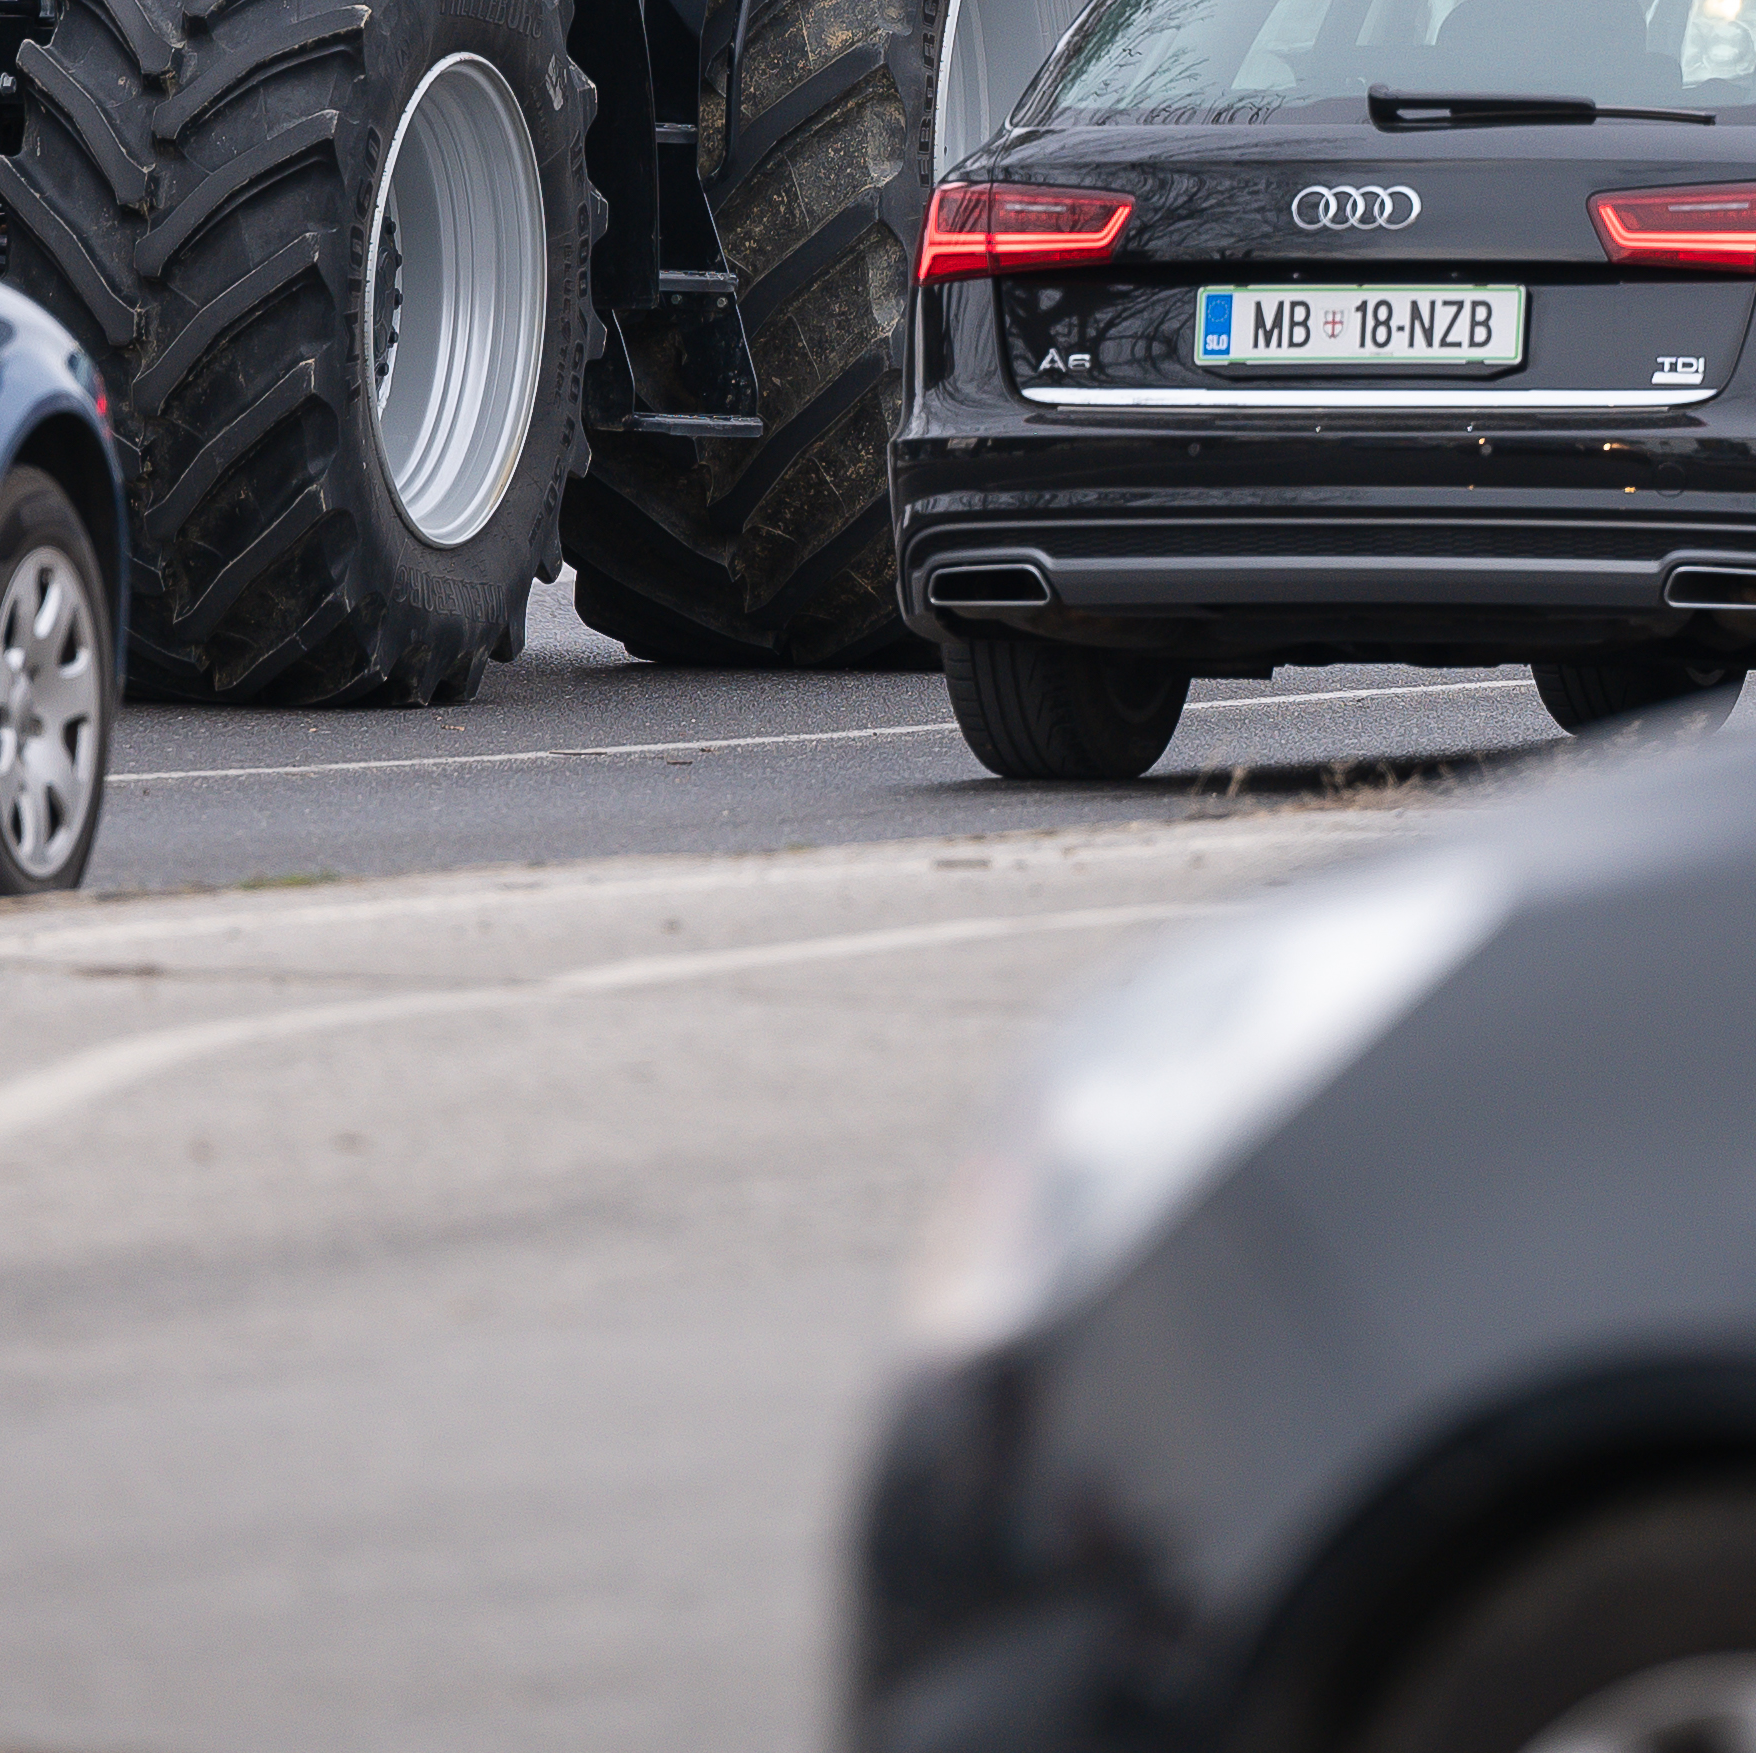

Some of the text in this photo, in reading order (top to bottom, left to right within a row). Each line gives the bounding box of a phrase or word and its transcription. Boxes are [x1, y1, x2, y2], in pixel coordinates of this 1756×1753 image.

[1251, 299, 1494, 350] MB 18-NZB
[1205, 334, 1229, 351] SLO
[1036, 347, 1092, 373] A6
[1656, 356, 1705, 373] TDI
